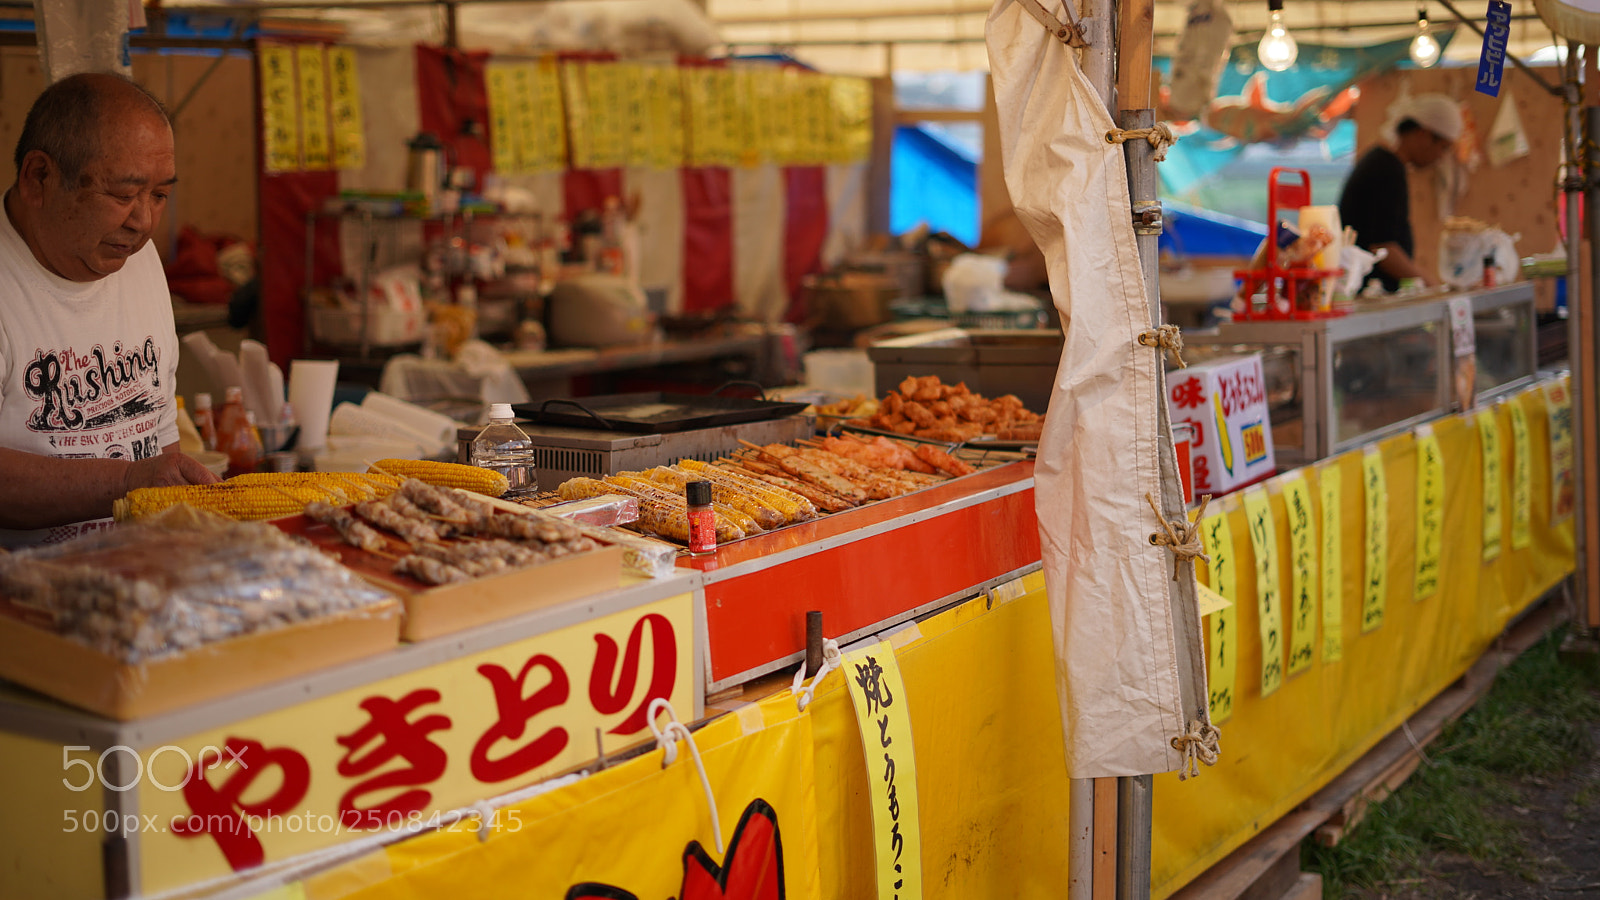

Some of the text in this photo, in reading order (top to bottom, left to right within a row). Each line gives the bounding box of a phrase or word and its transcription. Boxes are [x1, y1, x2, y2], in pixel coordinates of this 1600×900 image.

[23, 336, 161, 432] Rushing
[60, 347, 91, 374] The
[58, 435, 78, 447] THE
[80, 434, 100, 446] SKY
[102, 432, 115, 443] OF
[1211, 518, 1225, 668] ポテトライ
[169, 613, 677, 872] やきとり
[855, 655, 903, 900] 焼とうもろこ
